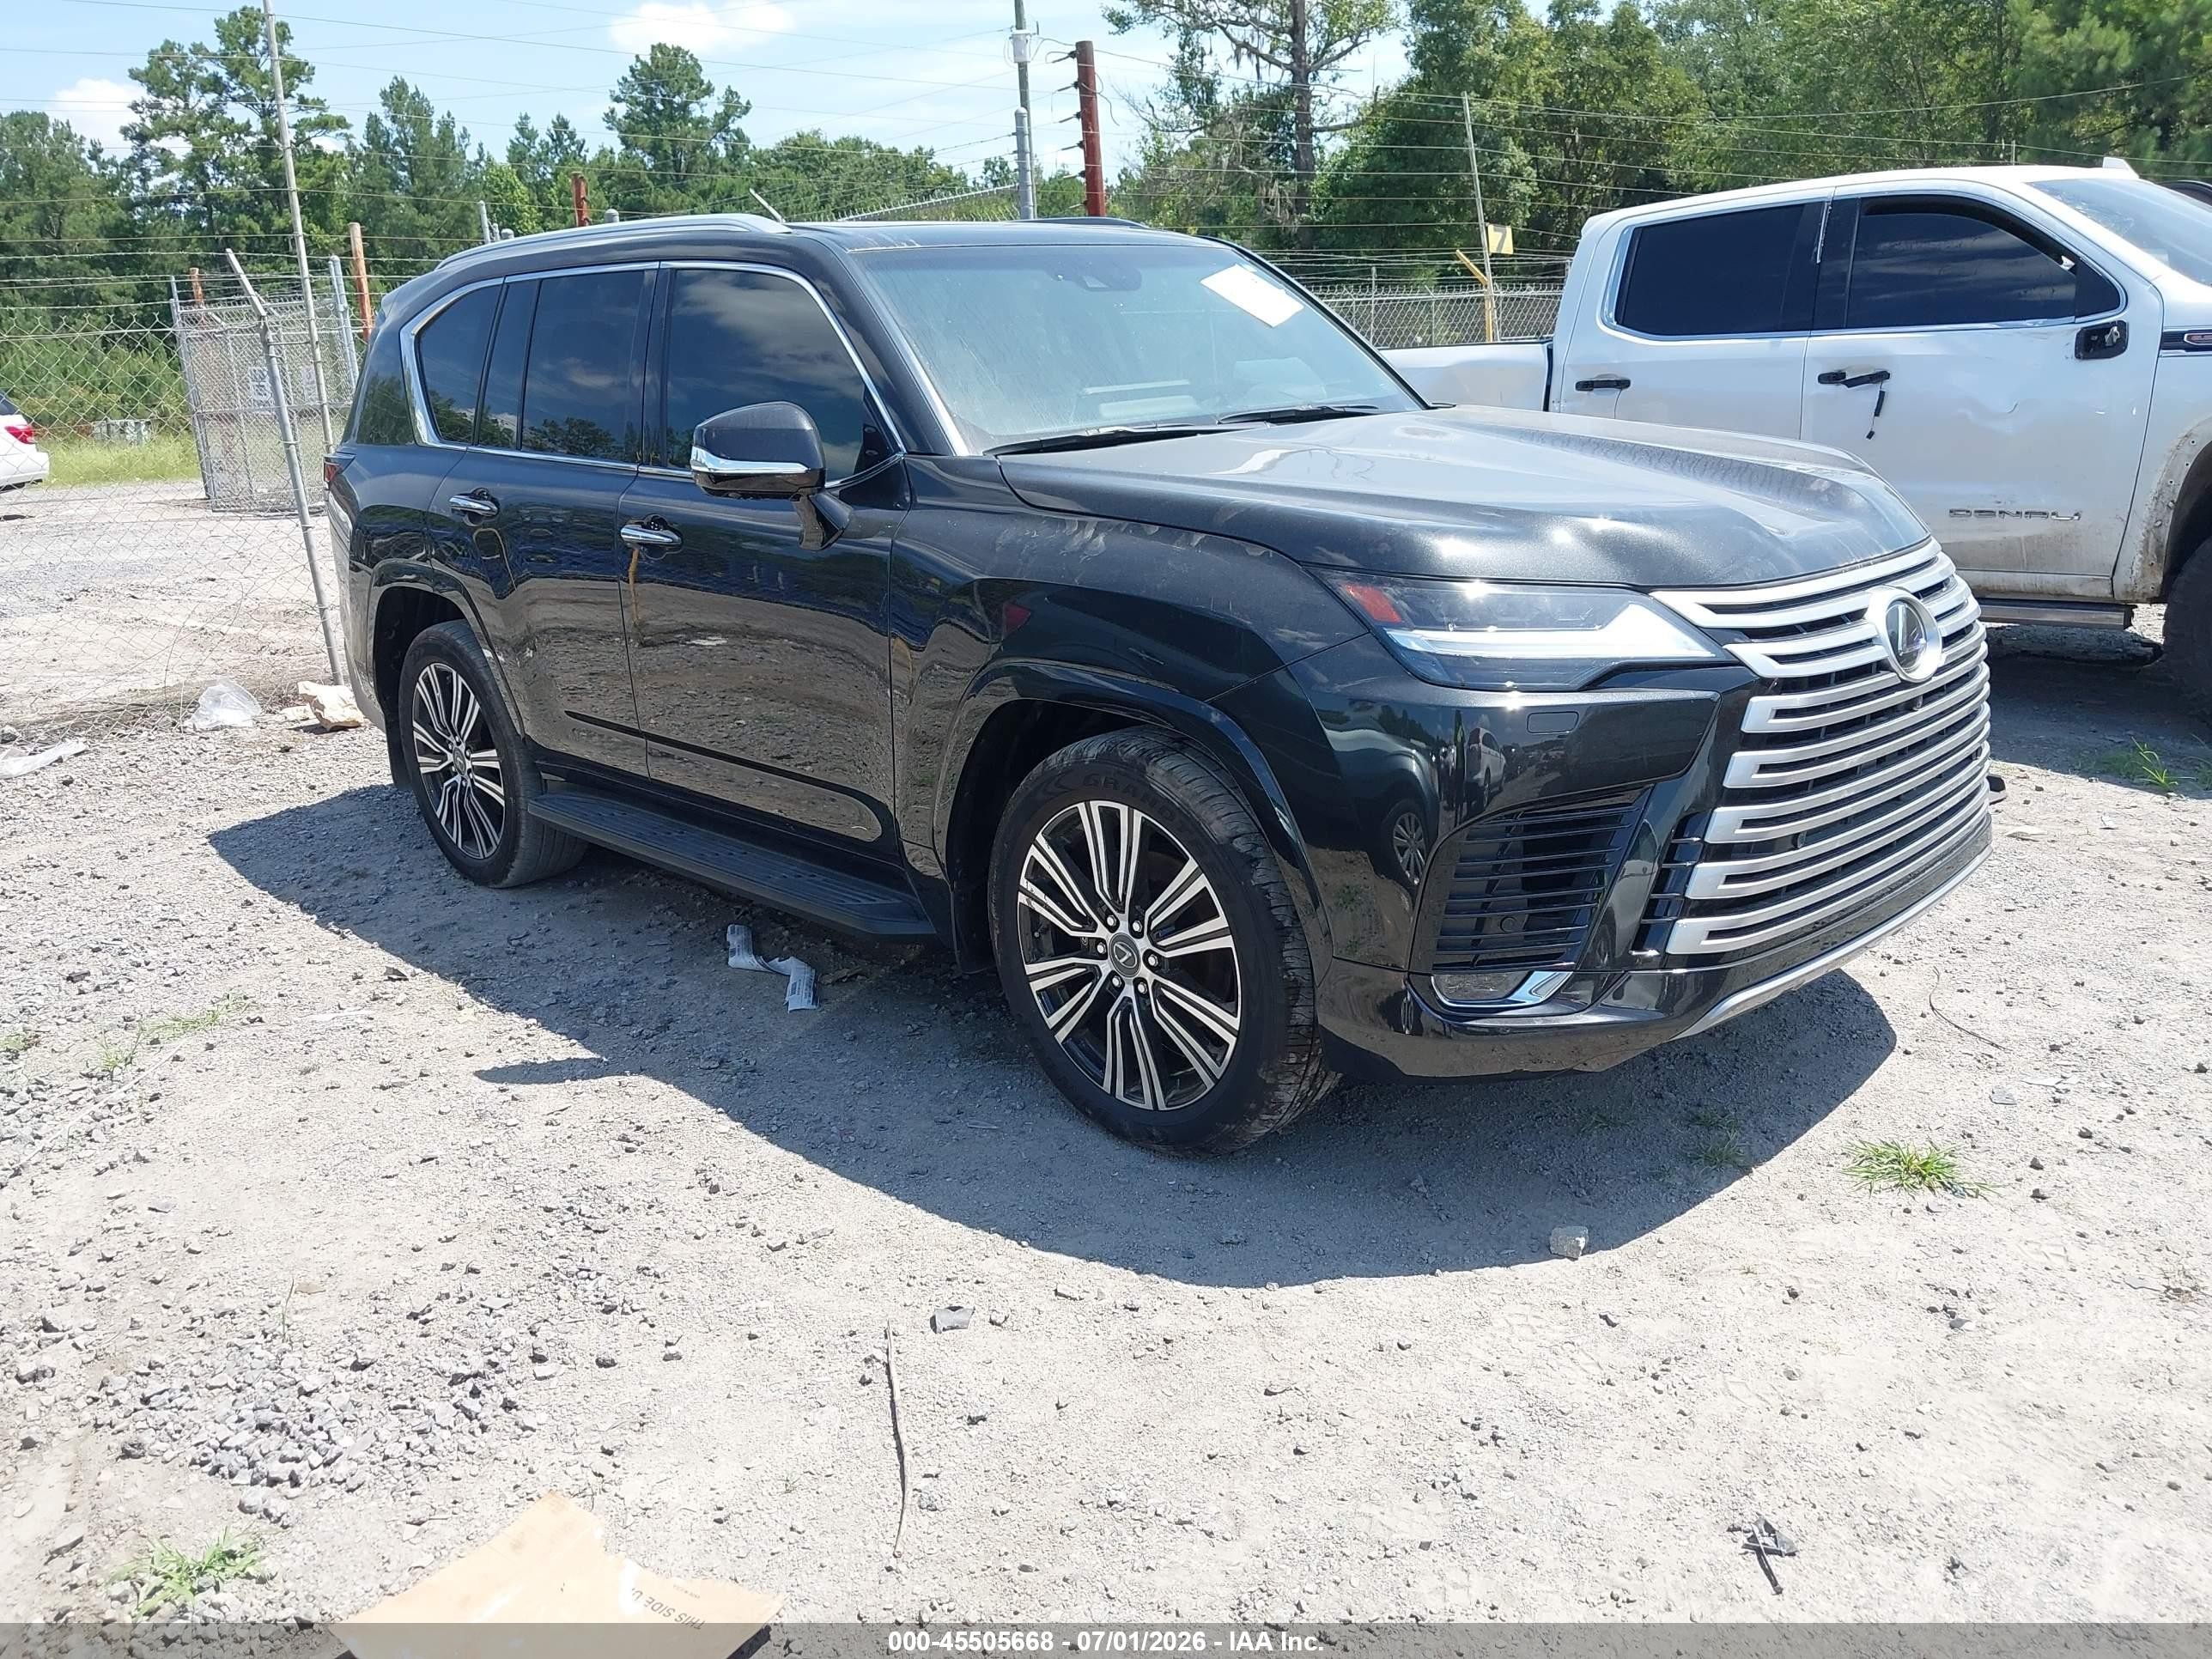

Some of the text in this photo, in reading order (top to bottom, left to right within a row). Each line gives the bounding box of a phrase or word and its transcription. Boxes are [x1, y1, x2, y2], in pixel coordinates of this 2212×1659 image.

[1493, 225, 1507, 253] 7
[1948, 508, 2081, 521] DENALI
[643, 1596, 676, 1618] SIDE
[674, 1613, 706, 1630] THIS
